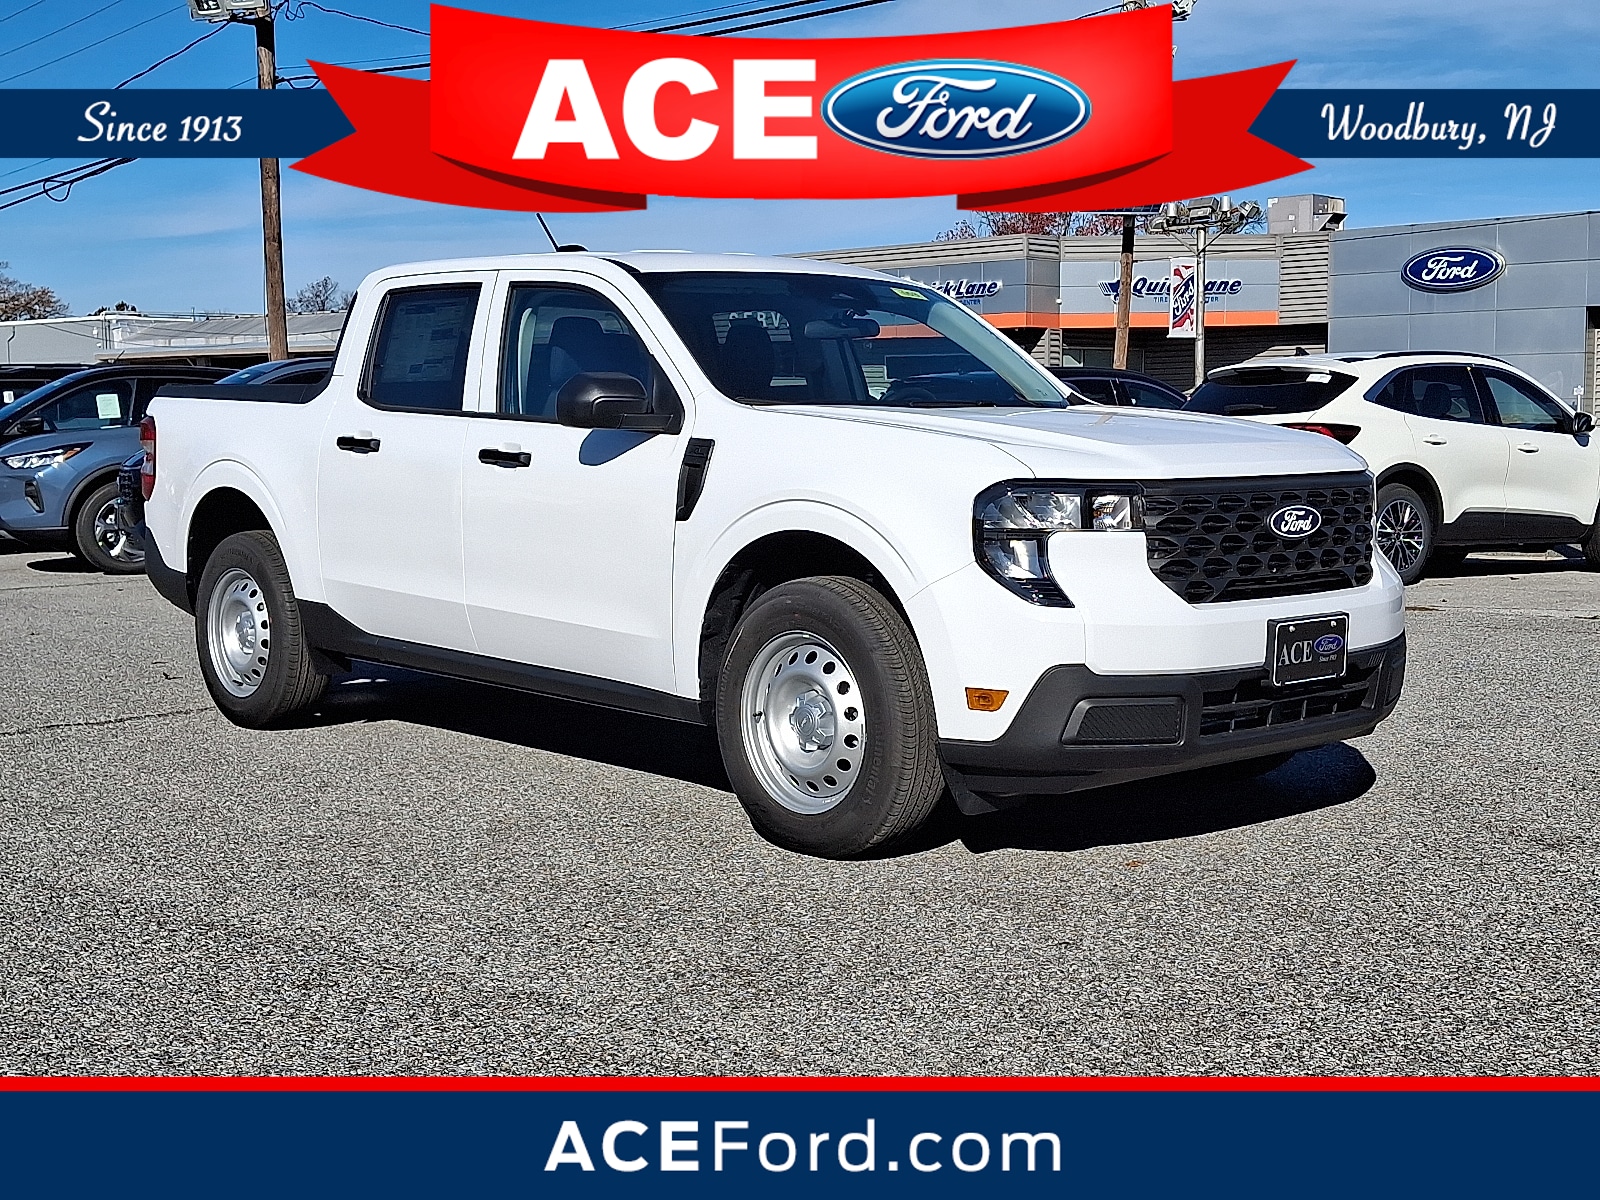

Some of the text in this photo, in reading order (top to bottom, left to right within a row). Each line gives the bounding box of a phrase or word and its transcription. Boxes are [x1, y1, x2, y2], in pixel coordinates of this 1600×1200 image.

[1421, 255, 1479, 281] Ford
[1173, 279, 1195, 316] Ford
[1280, 510, 1313, 532] Ford
[1278, 638, 1338, 666] ACE Ford
